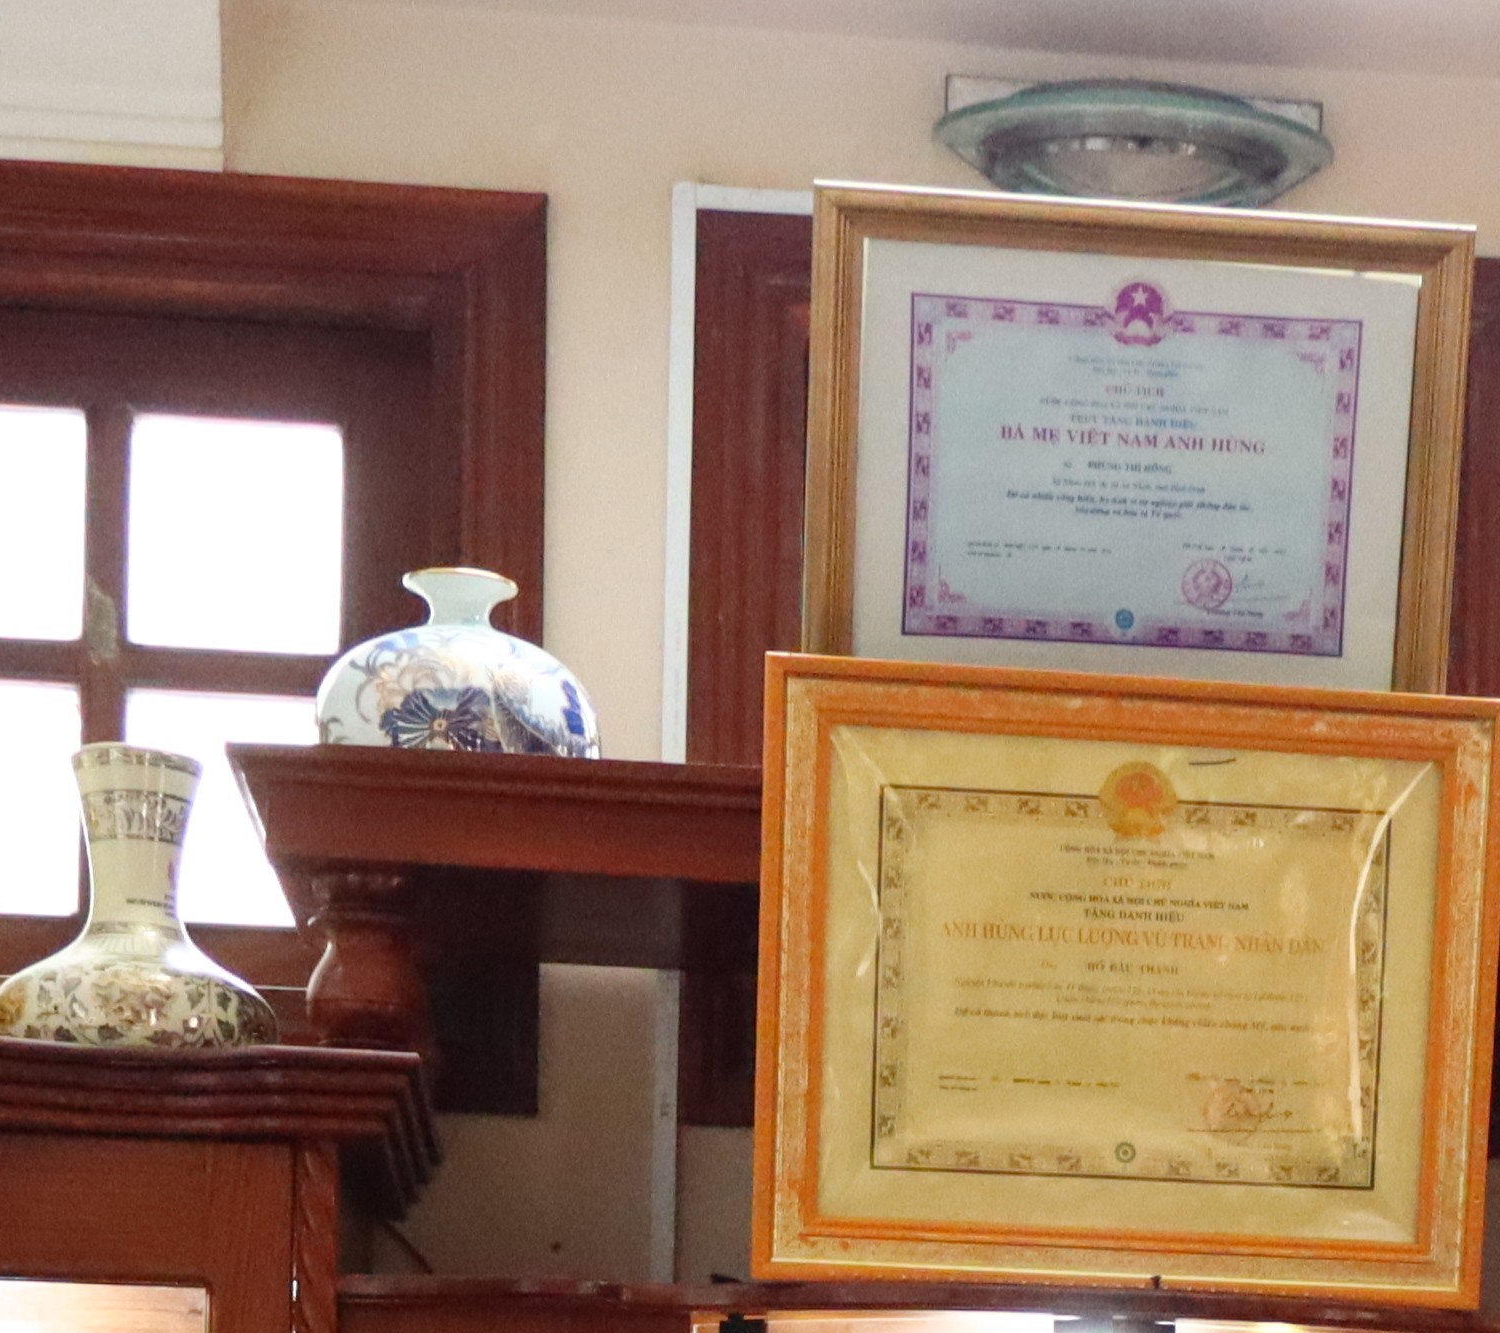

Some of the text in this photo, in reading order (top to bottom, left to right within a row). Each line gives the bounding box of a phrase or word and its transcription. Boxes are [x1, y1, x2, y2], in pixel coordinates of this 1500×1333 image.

[1032, 427, 1061, 445] MẸ
[1067, 426, 1110, 447] VIỆT
[1117, 430, 1159, 448] NAM
[1164, 434, 1204, 452] ANH
[1210, 434, 1266, 456] HÙNG
[1118, 910, 1151, 922] DANH
[943, 919, 978, 938] ANH
[982, 917, 1035, 942] HÙNG
[1038, 922, 1072, 946] LỰC
[1076, 925, 1139, 948] LƯỢNG
